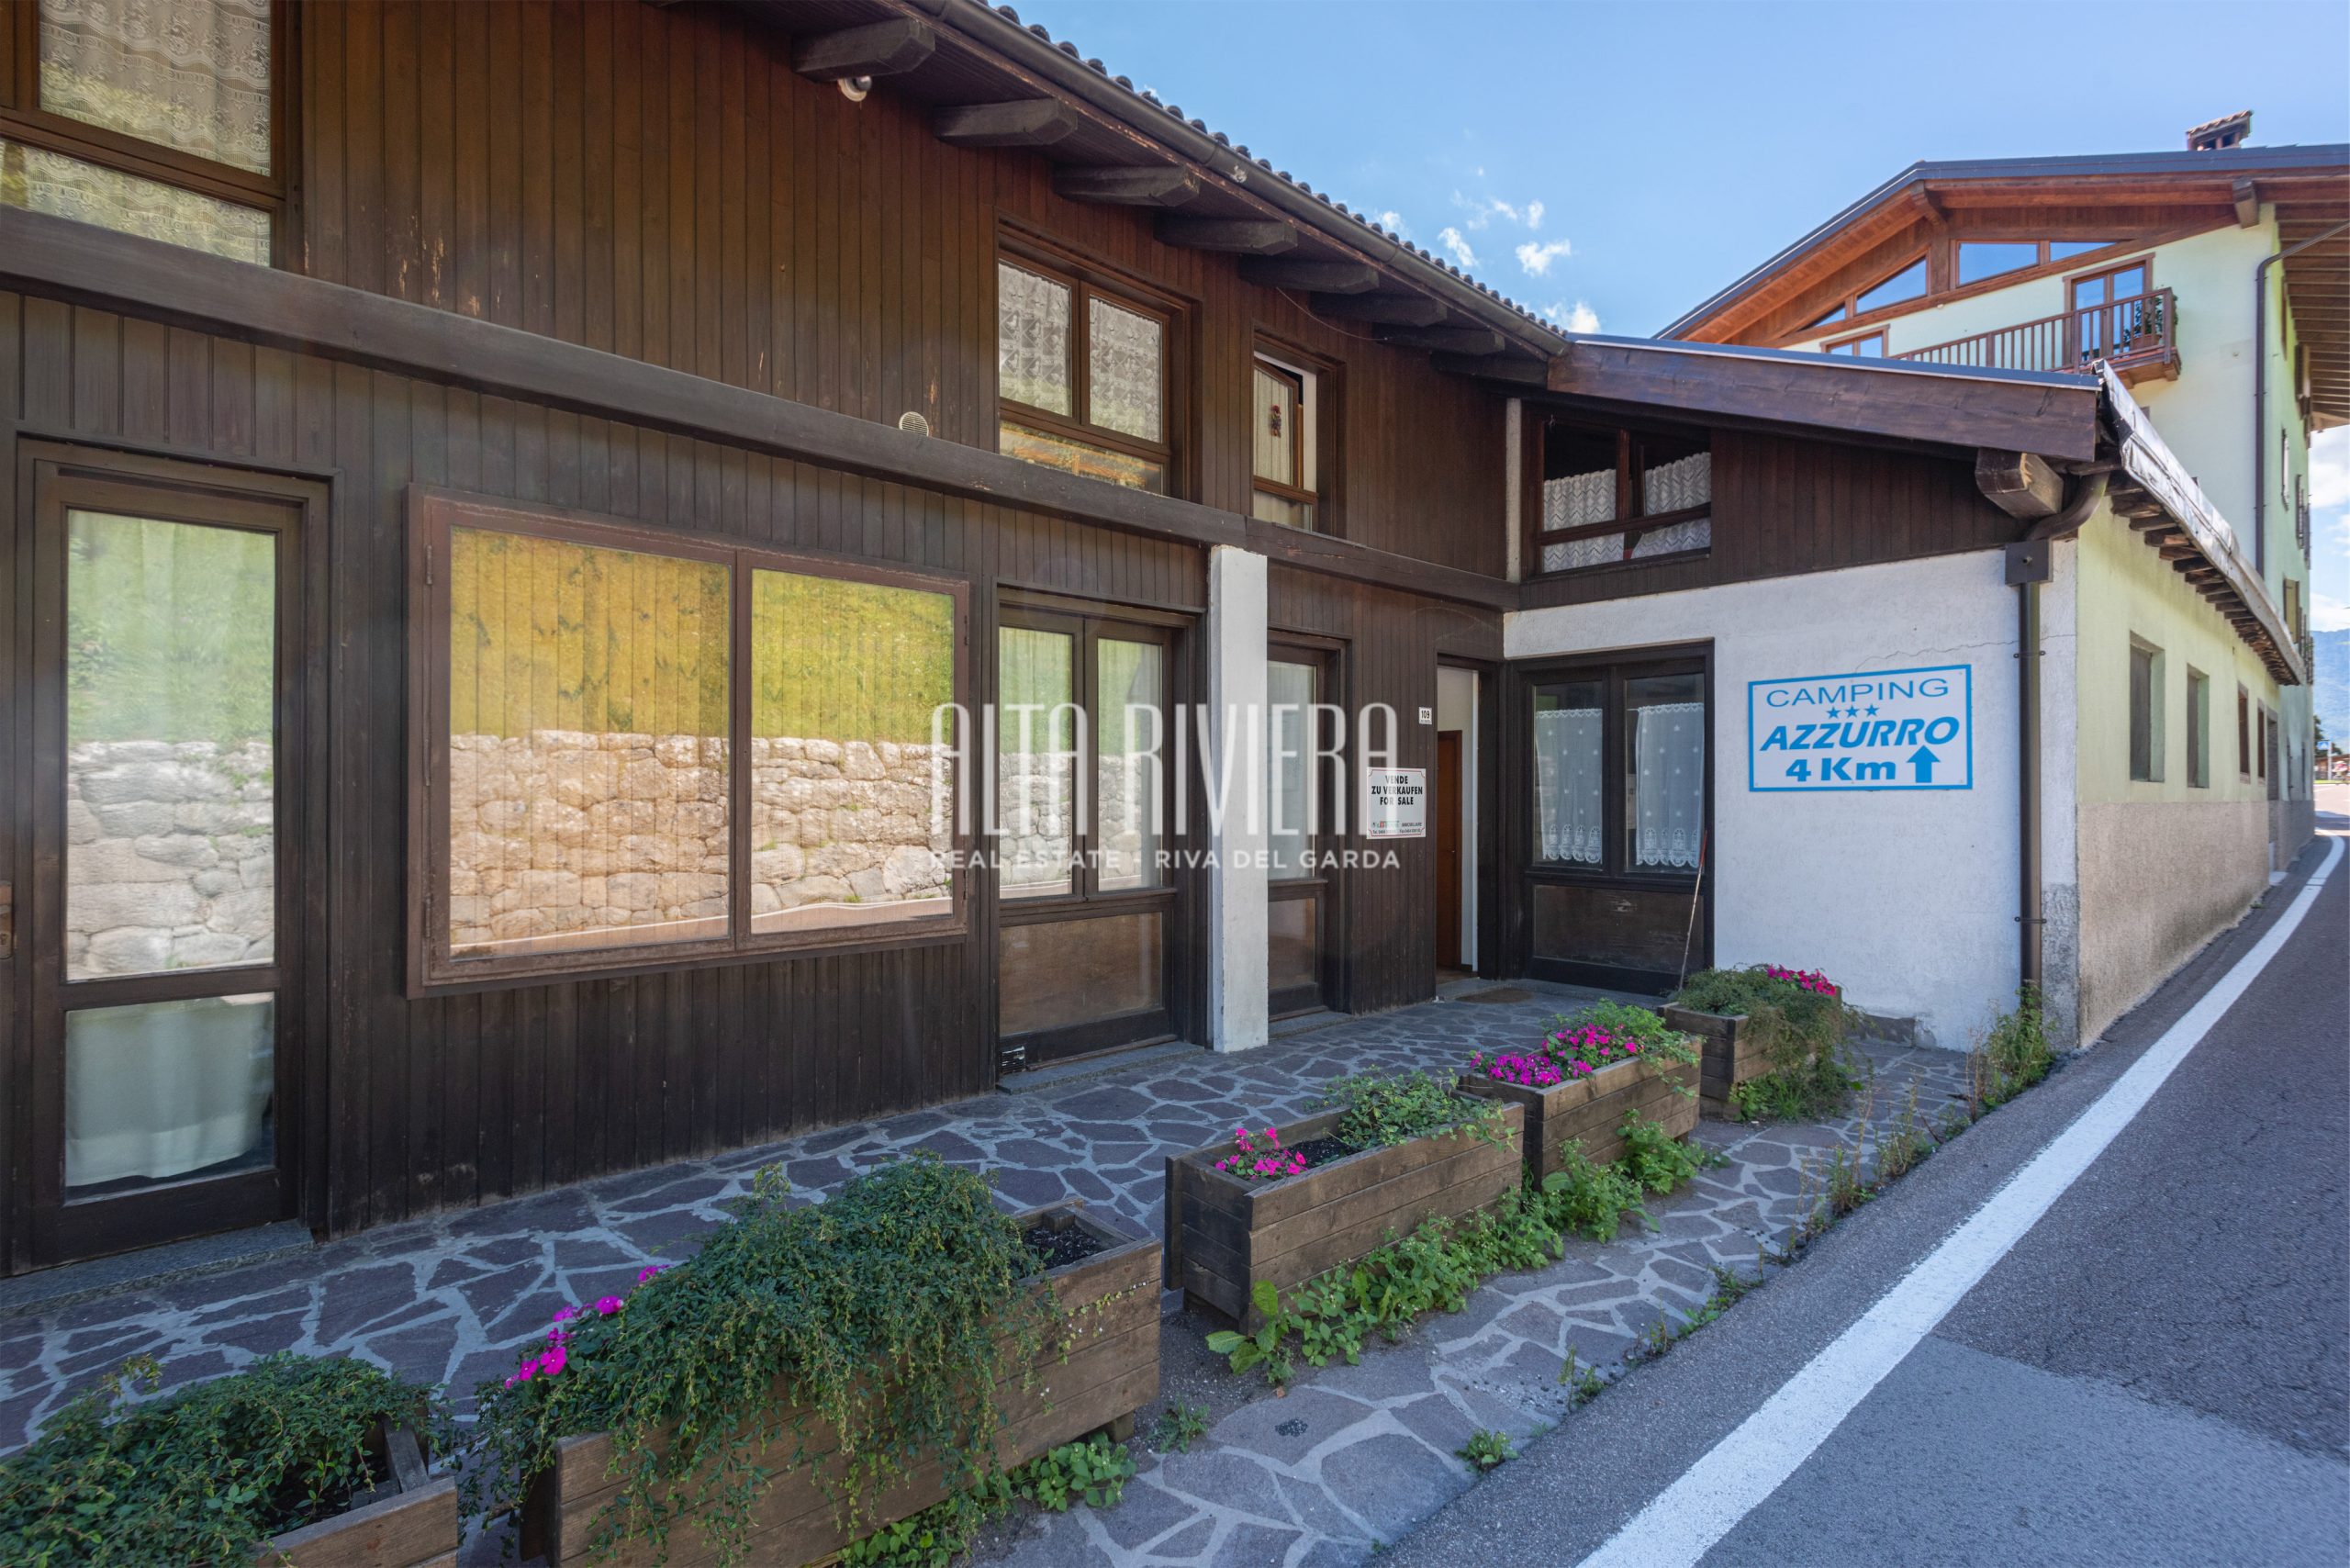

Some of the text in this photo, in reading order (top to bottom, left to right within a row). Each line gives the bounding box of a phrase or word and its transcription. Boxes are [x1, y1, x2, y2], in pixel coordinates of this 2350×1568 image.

[1766, 678, 1949, 707] CAMPING
[1759, 716, 1960, 751] AZZURRO
[1385, 776, 1408, 784] VENDE
[1371, 786, 1423, 795] ZU VERKAUFEN
[1380, 797, 1414, 805] FOR SALE
